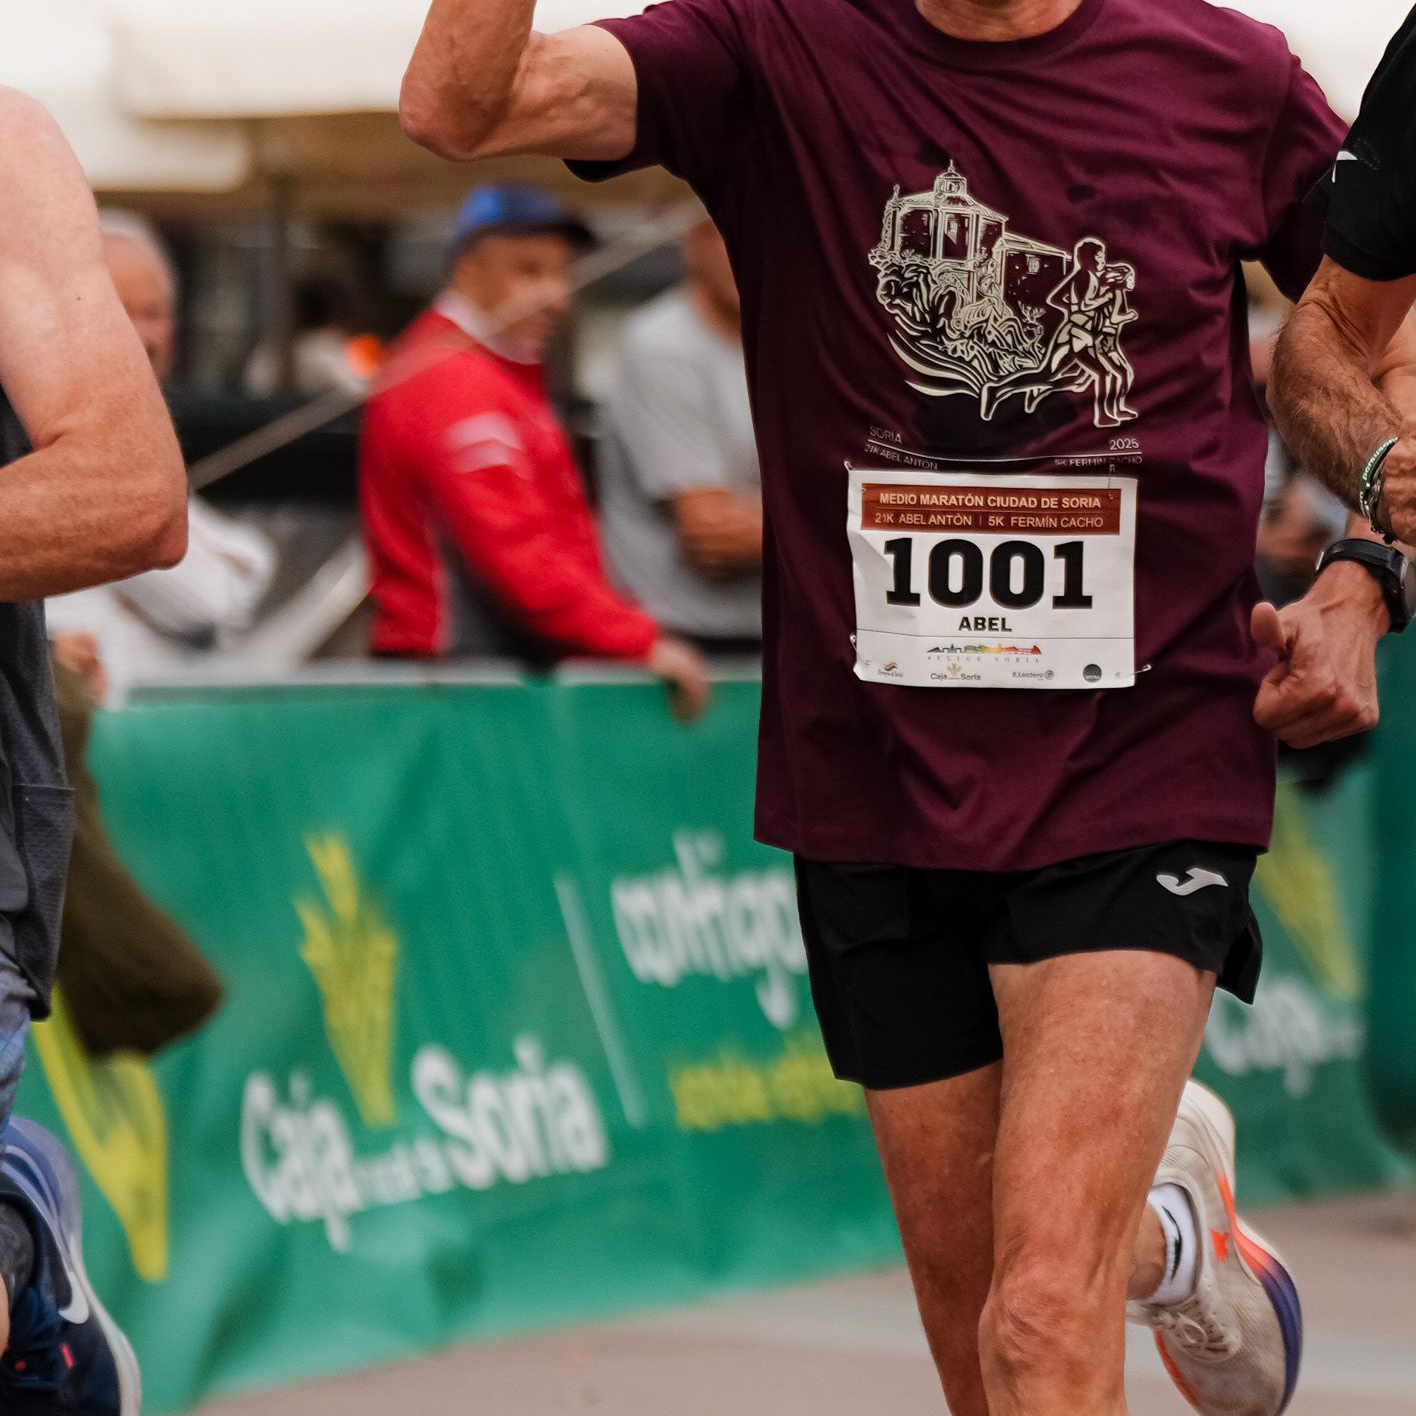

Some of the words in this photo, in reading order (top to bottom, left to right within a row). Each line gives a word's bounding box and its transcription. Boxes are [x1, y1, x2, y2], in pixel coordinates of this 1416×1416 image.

[869, 426, 903, 444] SORIA
[1109, 438, 1140, 451] 2025
[880, 448, 902, 463] ABEL
[879, 492, 919, 506] MEDIO
[920, 492, 984, 507] MARATÓN
[987, 495, 1039, 508] CIUDAD
[1041, 497, 1059, 509] DE
[1061, 497, 1102, 509] SORIA
[874, 512, 894, 524] 21K
[898, 513, 928, 525] ABEL
[928, 512, 973, 526] ANTÓN
[988, 516, 1004, 527] 5K
[1010, 514, 1058, 528] FERMÍN
[1060, 517, 1104, 528] CACHO
[884, 537, 1093, 610] 1001
[958, 616, 1013, 632] ABEL
[930, 672, 948, 681] Caja
[960, 672, 982, 681] Soria
[411, 1036, 609, 1189] Soria
